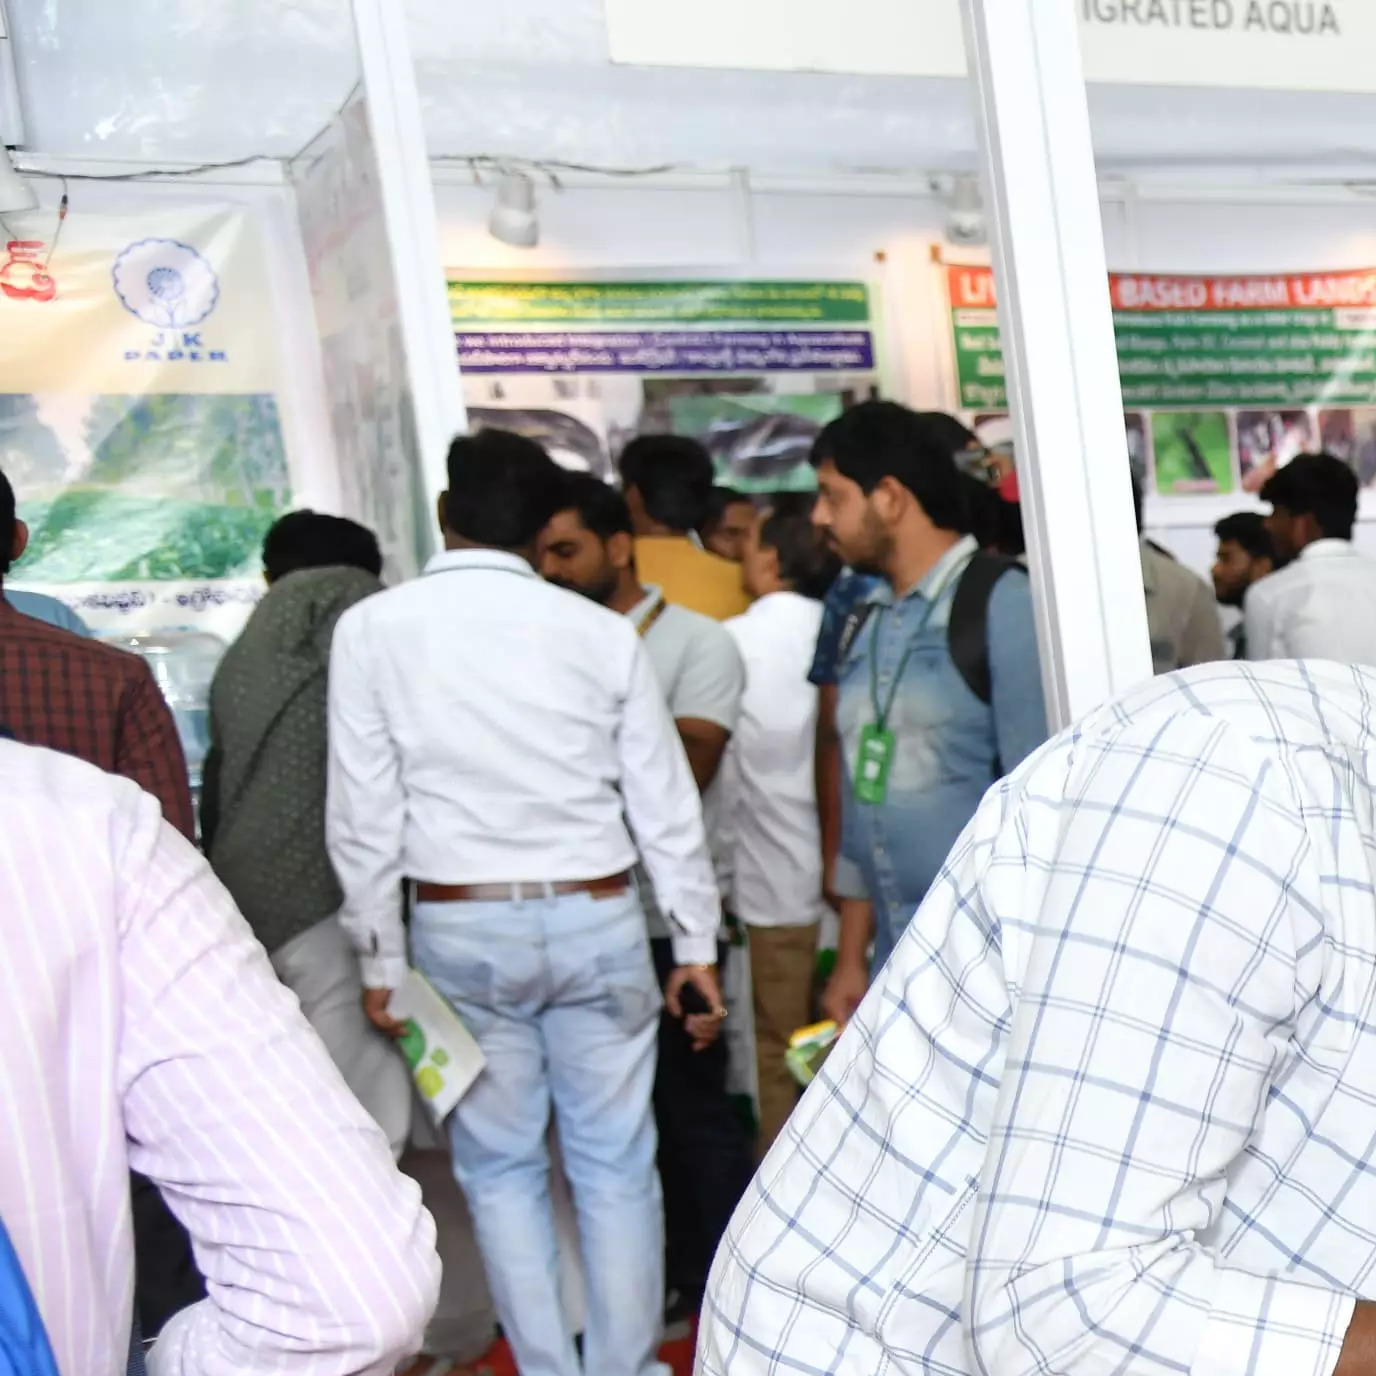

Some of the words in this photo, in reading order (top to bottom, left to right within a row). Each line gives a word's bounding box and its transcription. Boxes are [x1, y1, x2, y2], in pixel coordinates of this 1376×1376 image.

[1244, 0, 1341, 35] AQUA
[1116, 276, 1208, 308] BASED
[1213, 276, 1288, 307] FARM
